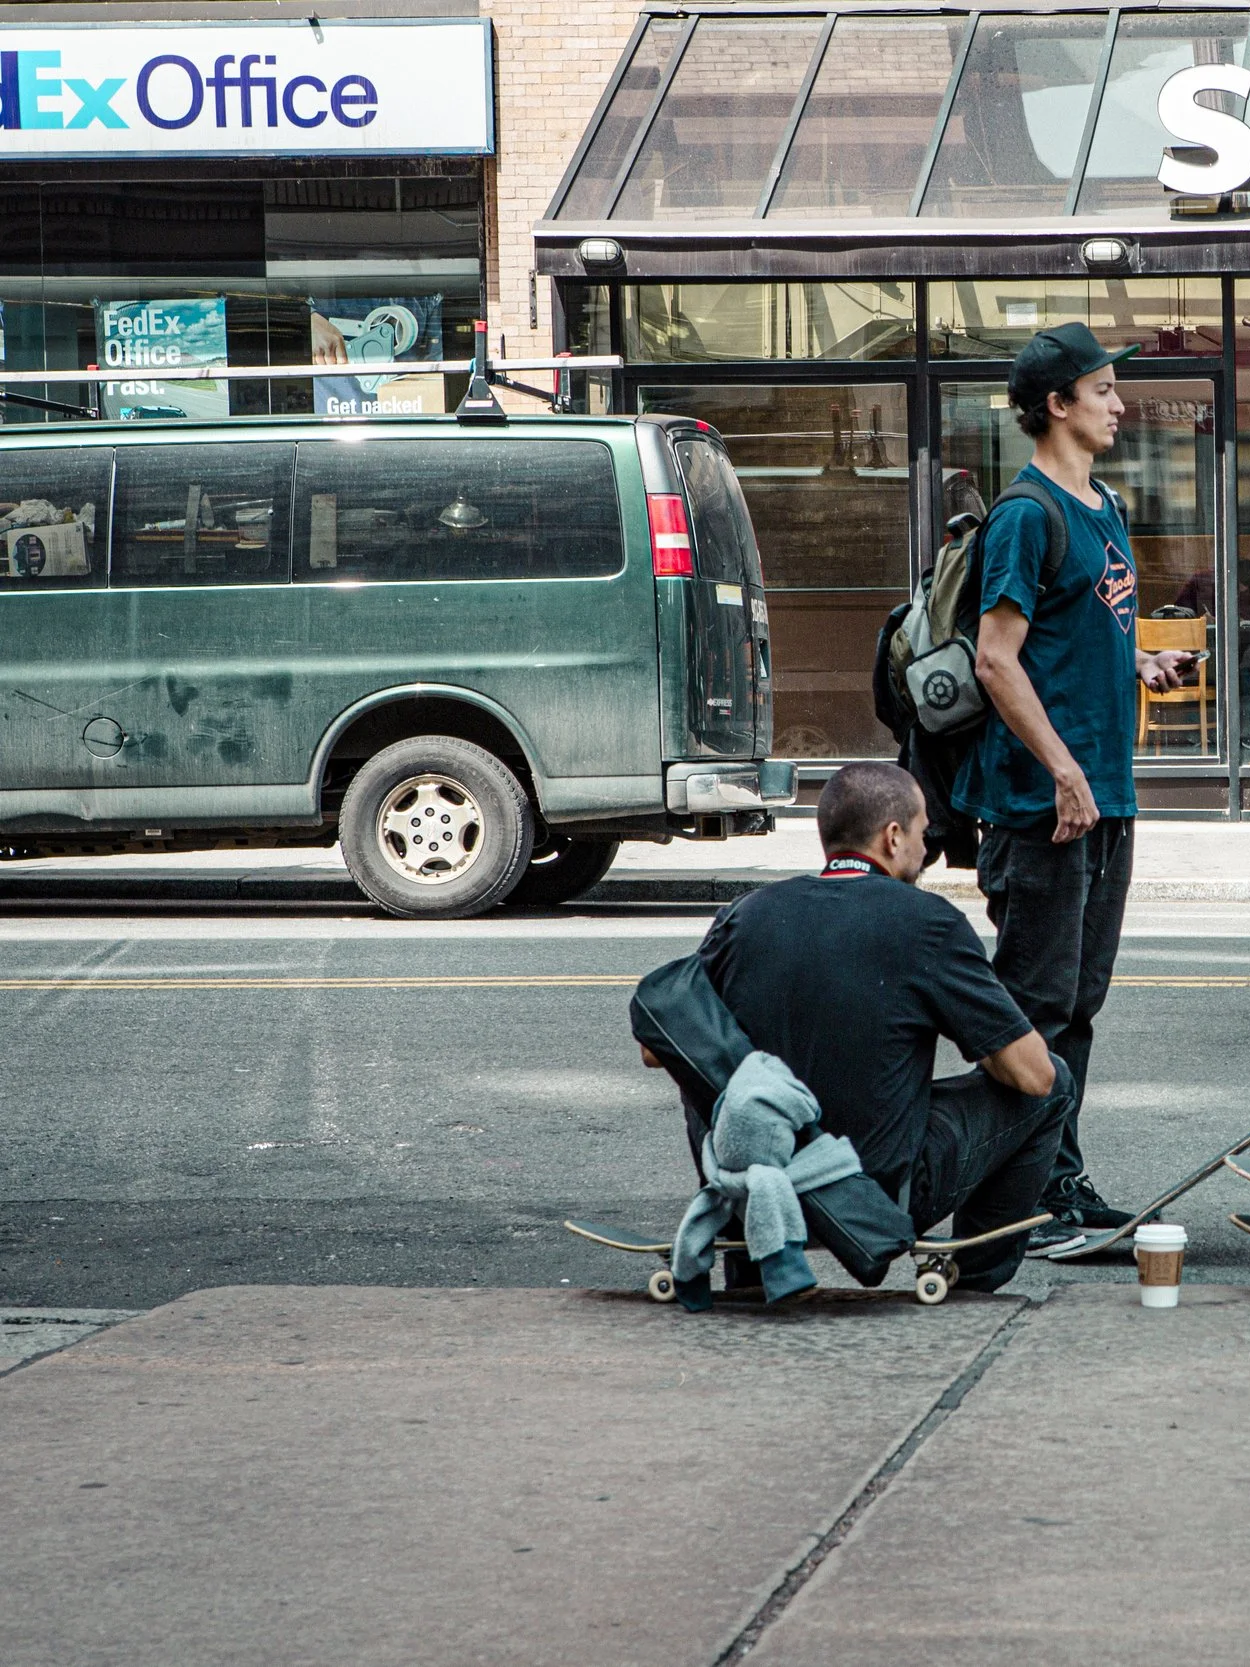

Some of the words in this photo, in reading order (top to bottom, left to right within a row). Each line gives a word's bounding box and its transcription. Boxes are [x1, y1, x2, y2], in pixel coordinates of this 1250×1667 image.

[136, 54, 379, 129] Office
[103, 309, 181, 337] FedEx
[104, 339, 181, 367] Office
[326, 396, 358, 414] Get
[829, 859, 871, 872] Canon
